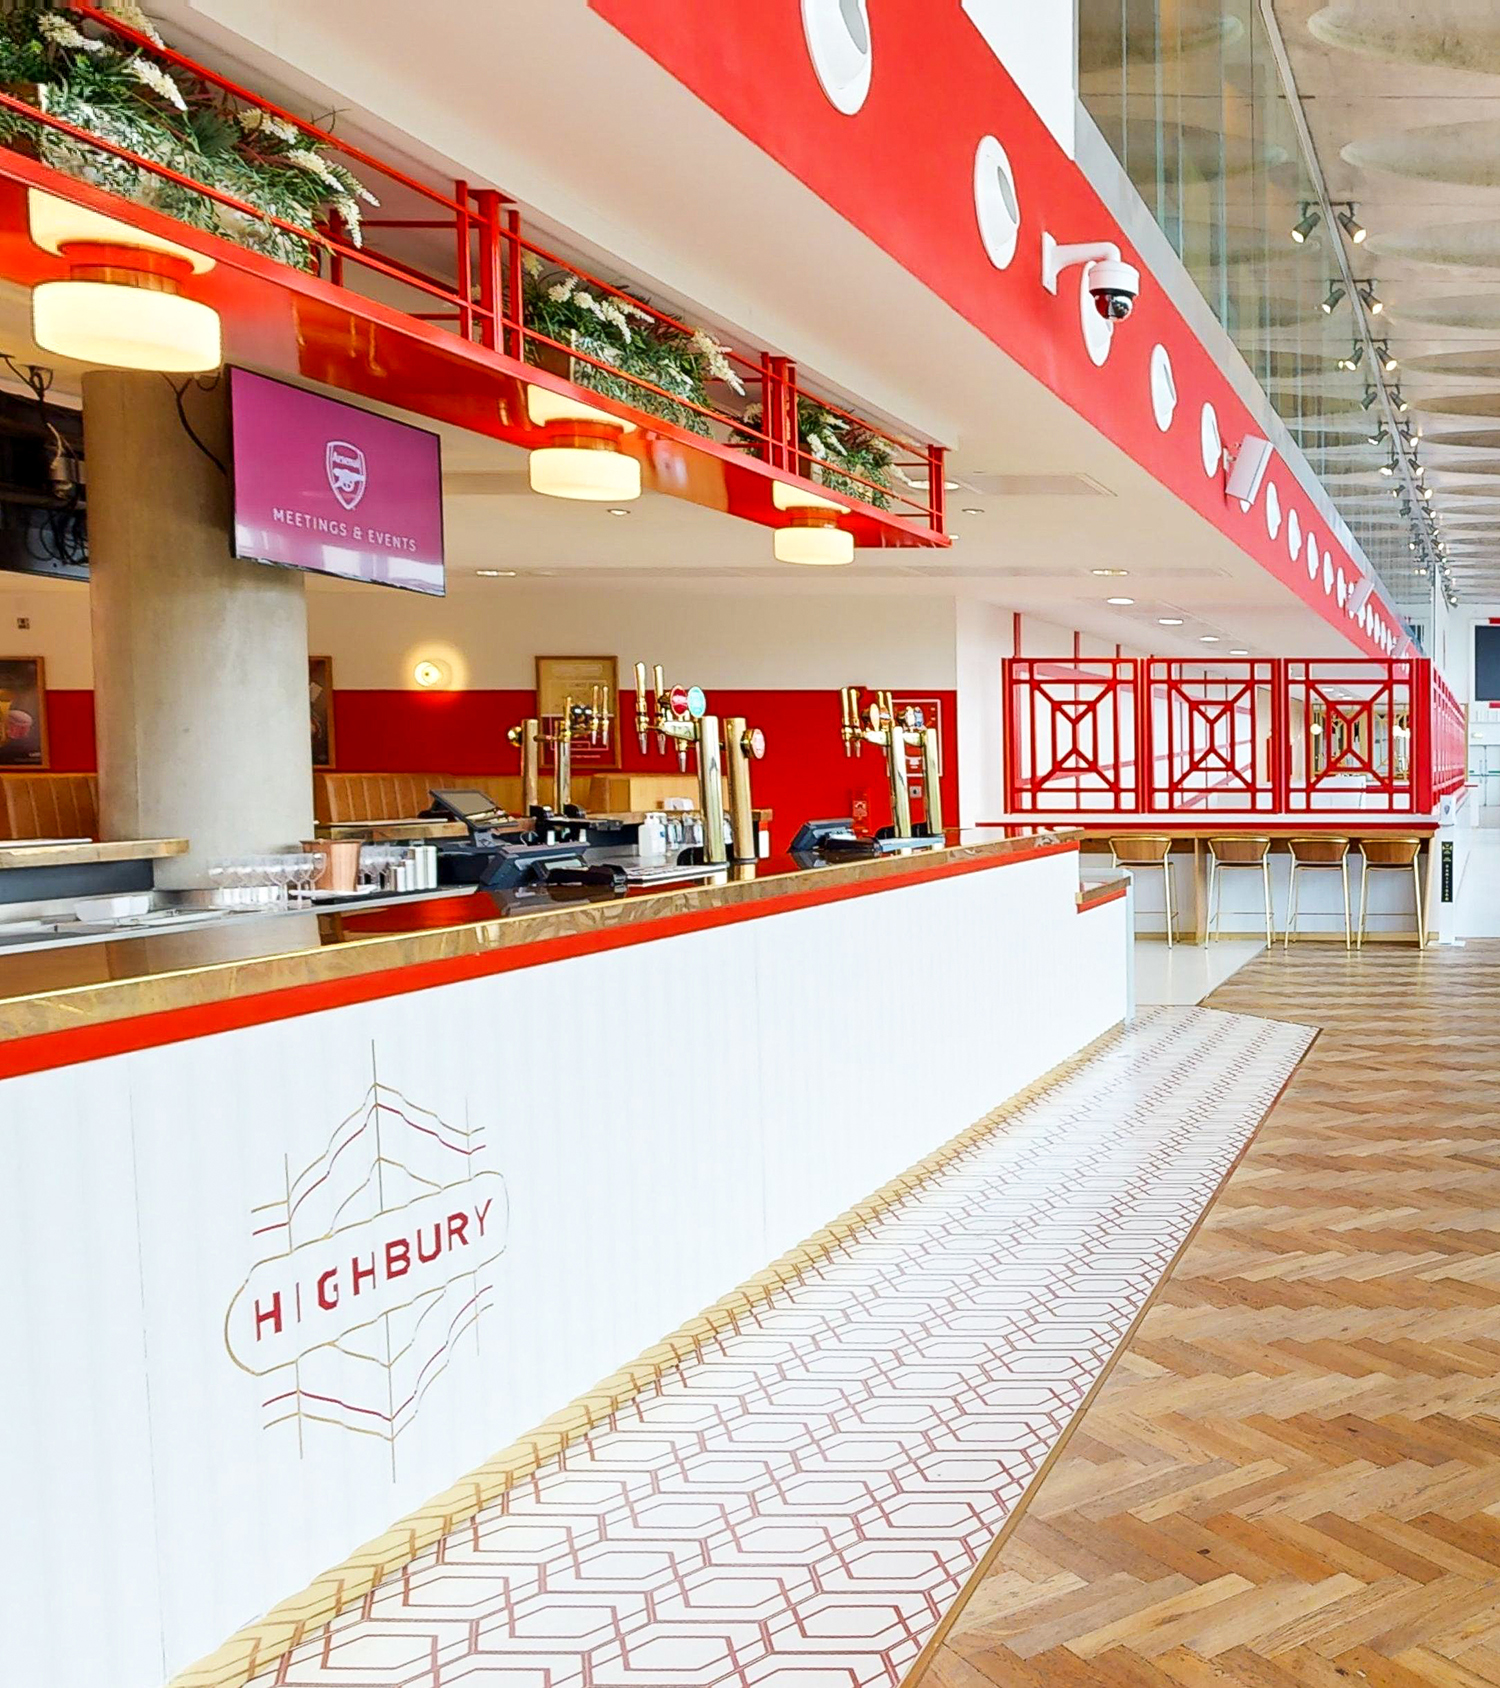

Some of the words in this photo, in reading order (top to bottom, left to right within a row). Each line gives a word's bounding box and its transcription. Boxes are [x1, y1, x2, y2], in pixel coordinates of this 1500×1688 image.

[272, 507, 347, 537] MEETINGS
[352, 526, 363, 540] &
[368, 529, 417, 552] EVENTS
[254, 1198, 493, 1342] HIGHBURY
